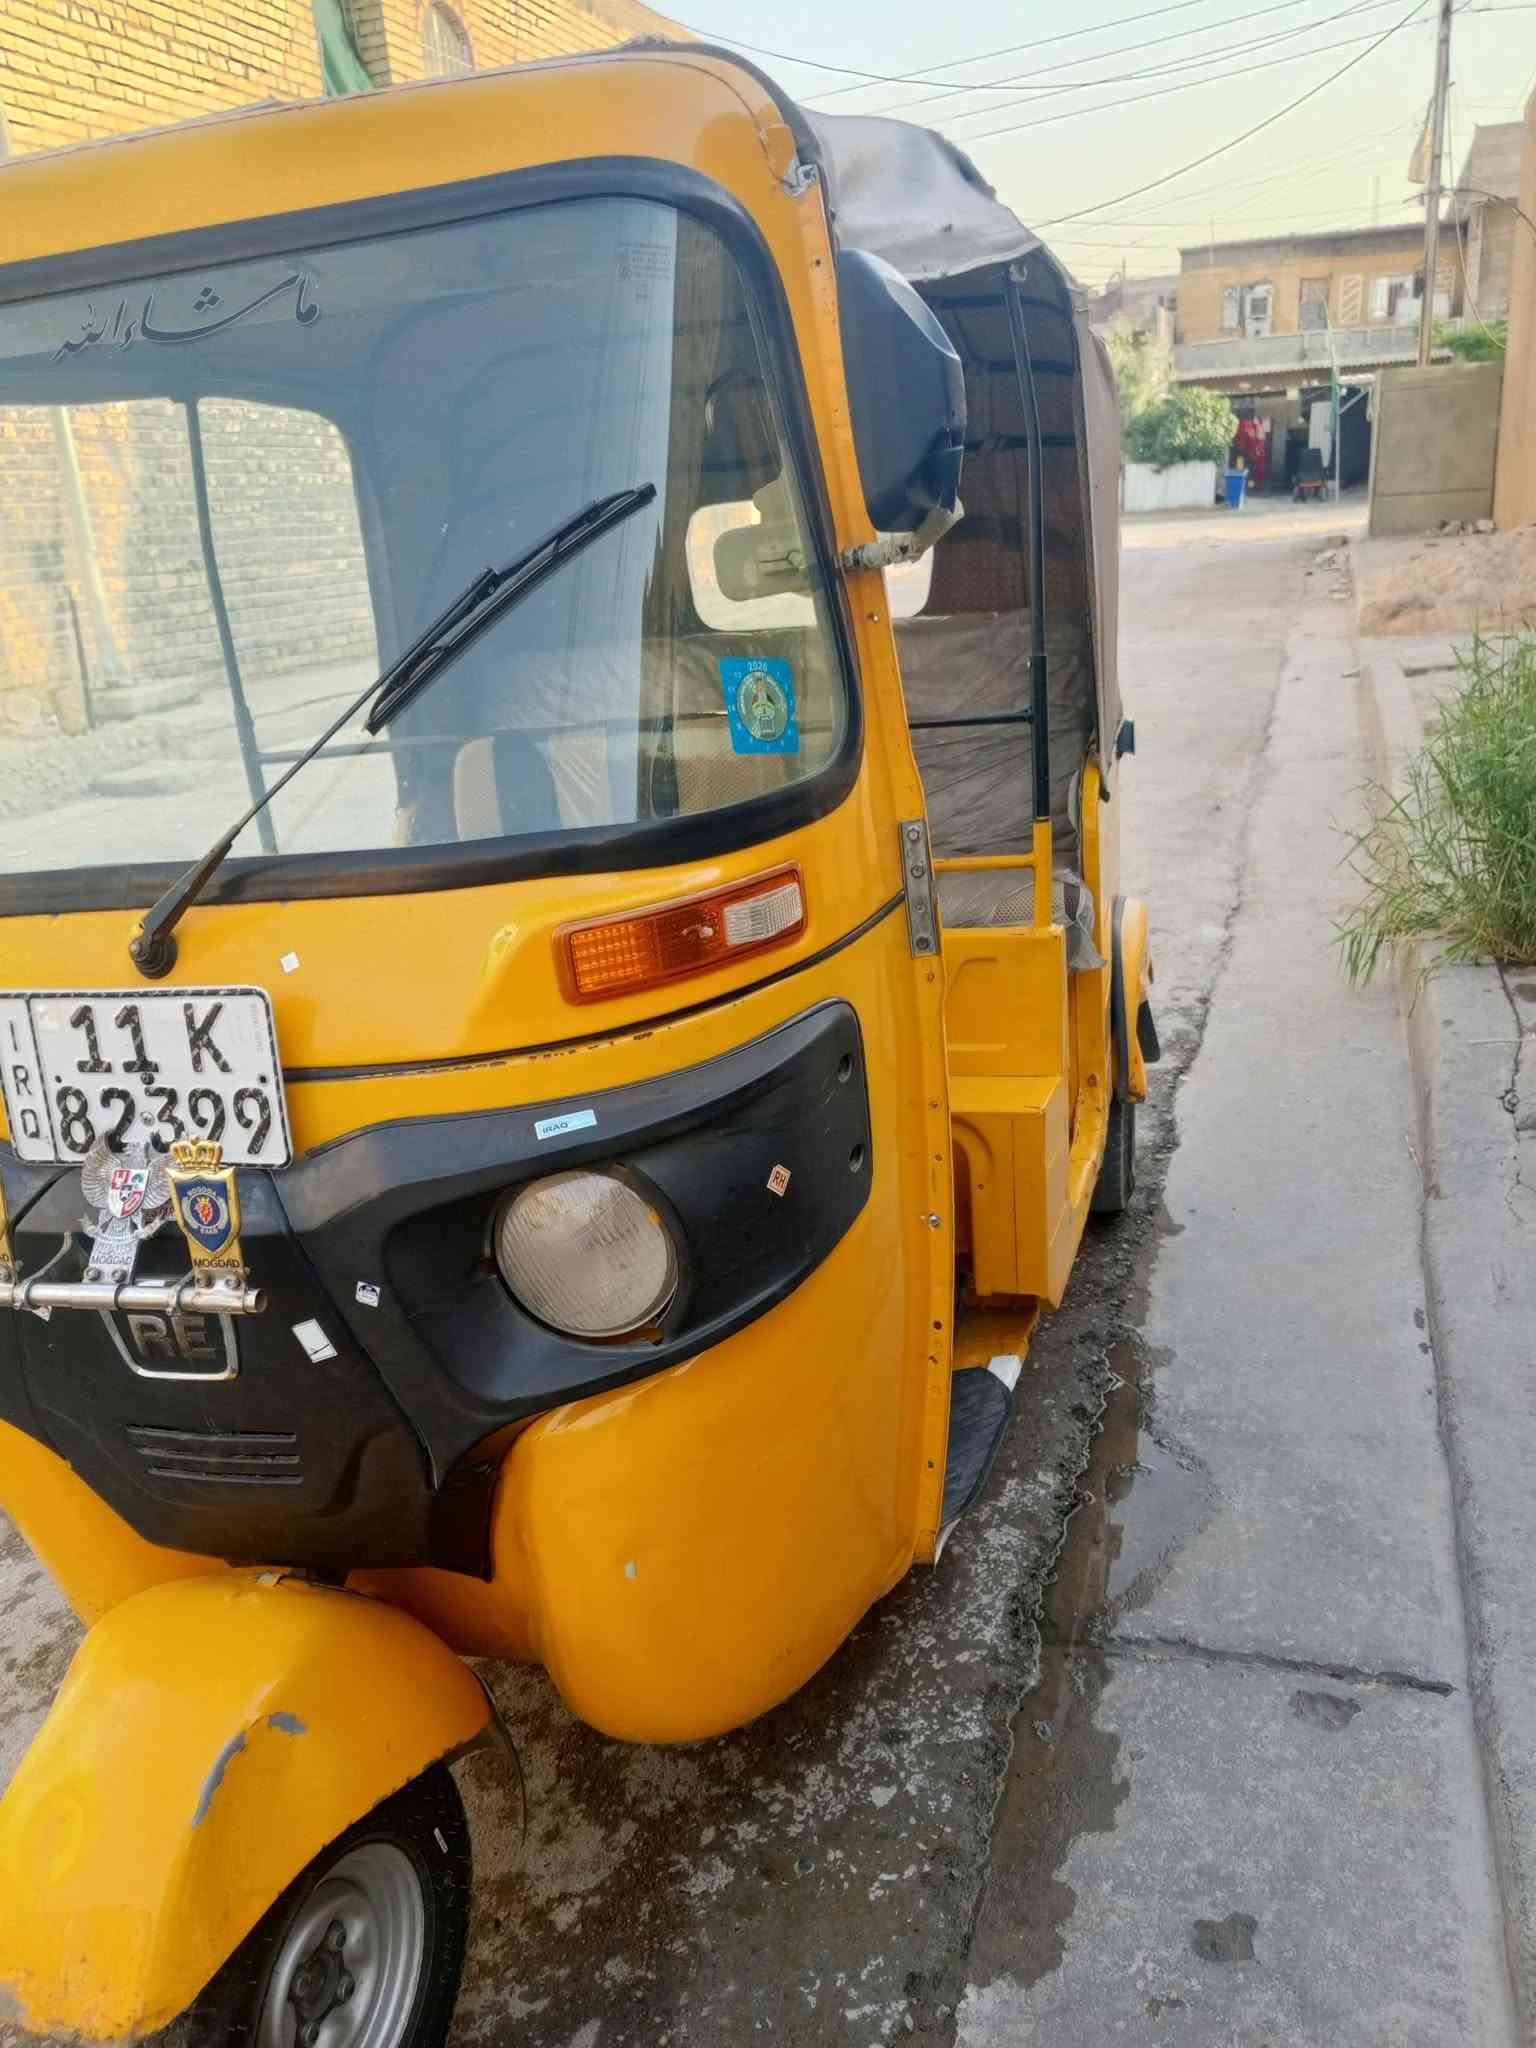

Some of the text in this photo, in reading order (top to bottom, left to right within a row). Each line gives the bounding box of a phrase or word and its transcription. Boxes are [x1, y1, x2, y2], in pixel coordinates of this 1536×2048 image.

[70, 1004, 159, 1073] 11
[184, 1003, 232, 1072] K
[55, 1086, 272, 1154] 82399
[127, 1314, 217, 1358] RE
